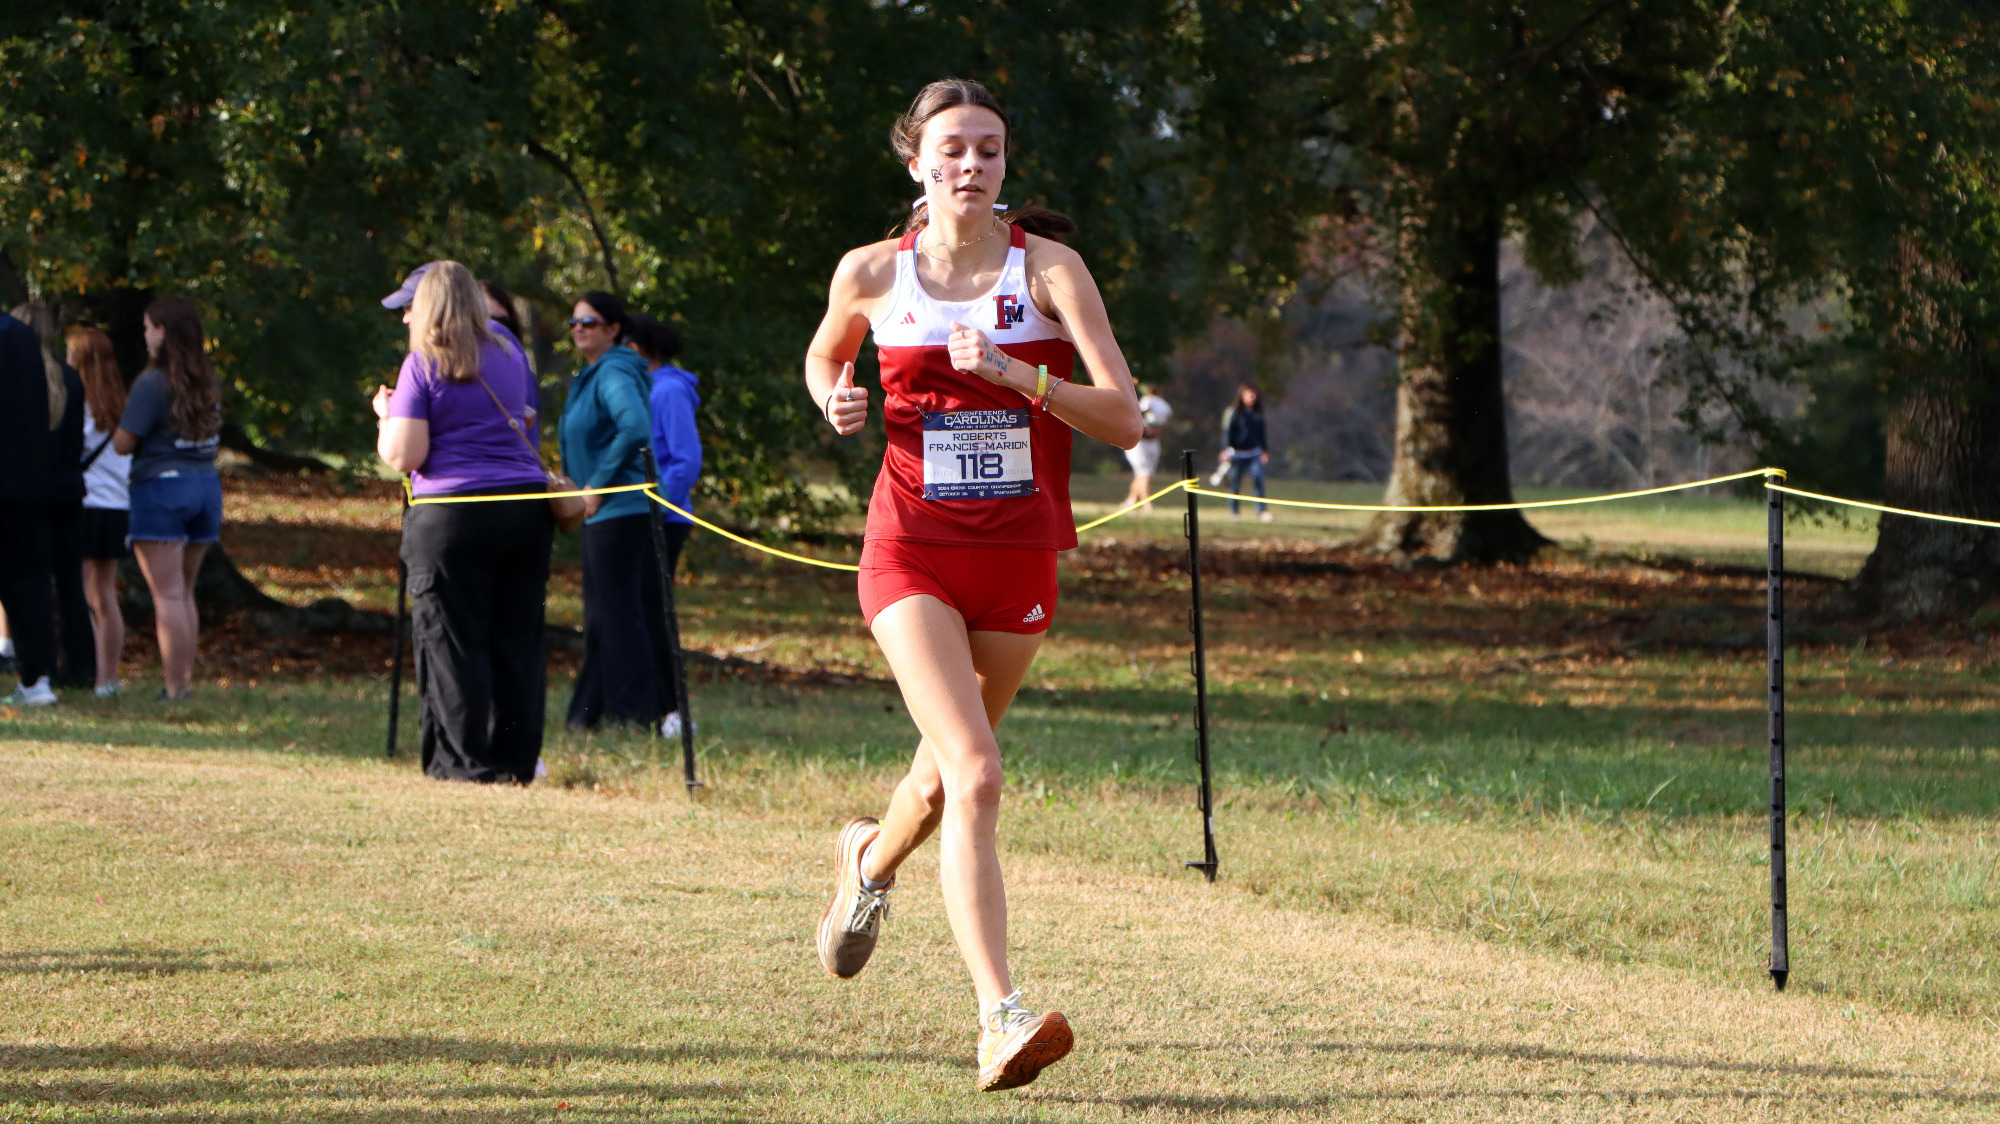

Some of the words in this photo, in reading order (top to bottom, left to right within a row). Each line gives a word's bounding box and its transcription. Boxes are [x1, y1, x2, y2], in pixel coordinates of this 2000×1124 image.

[944, 415, 1018, 426] CAROLINAS
[952, 431, 1007, 441] ROBERTS
[929, 442, 979, 452] FRANCIS
[985, 440, 1028, 451] MARION
[956, 453, 1004, 480] 118
